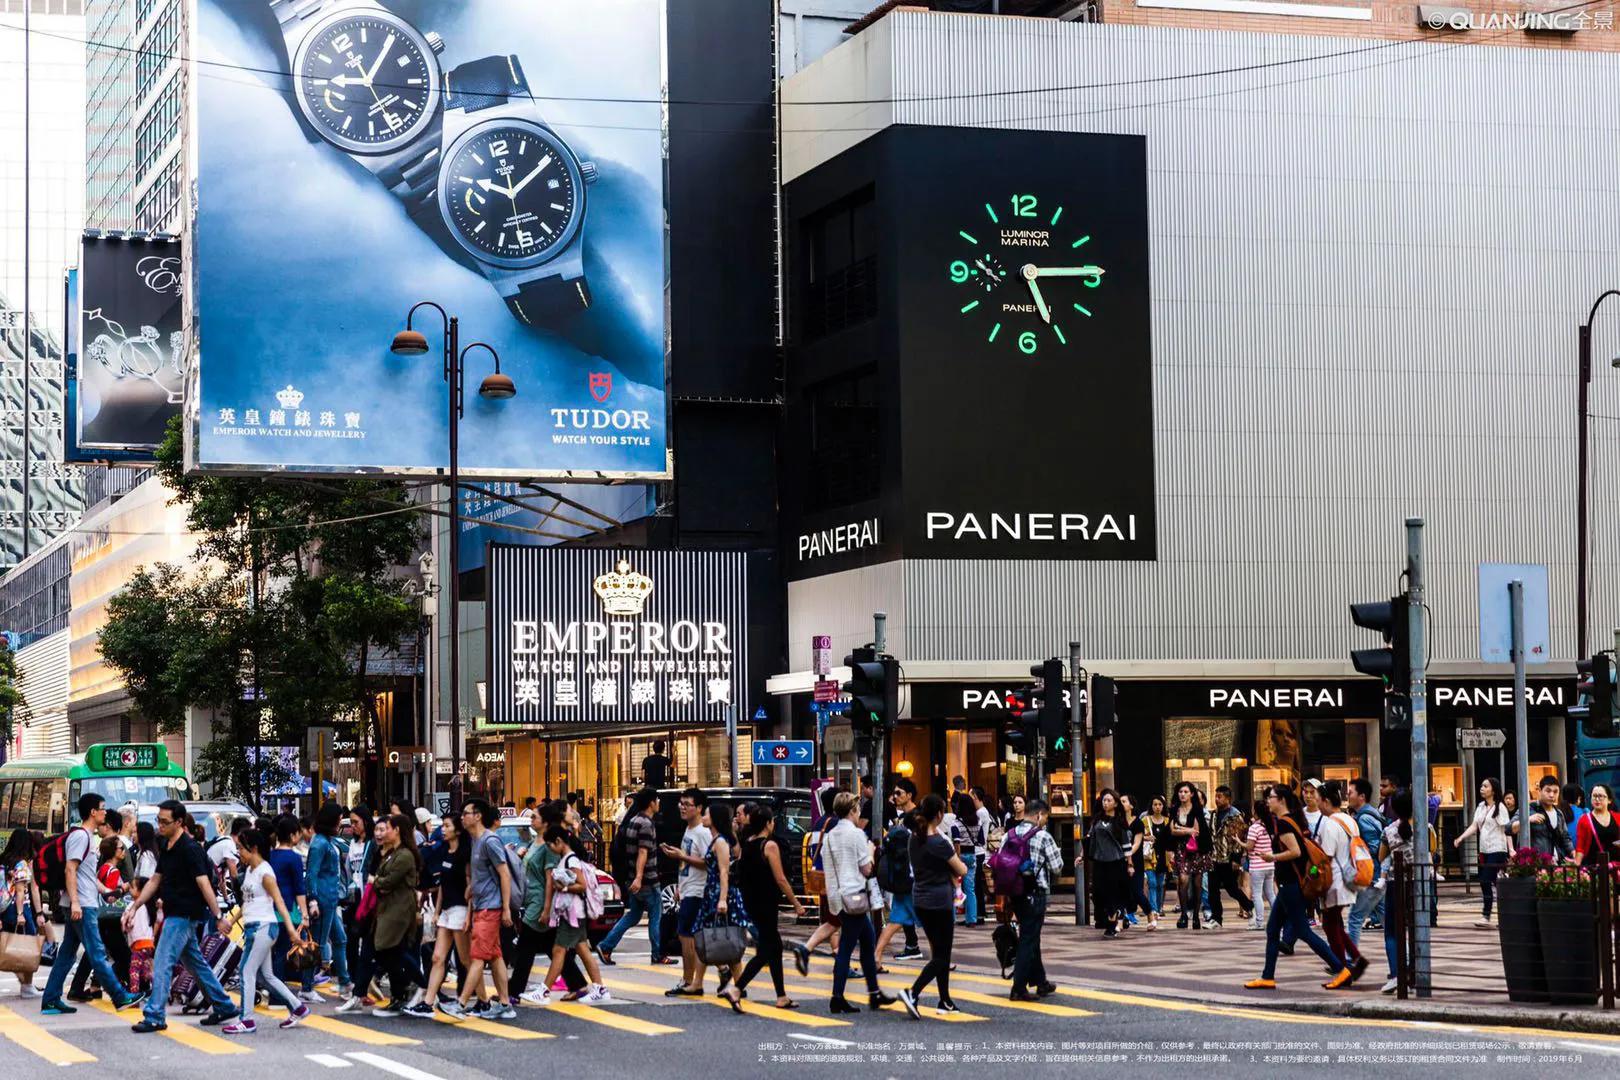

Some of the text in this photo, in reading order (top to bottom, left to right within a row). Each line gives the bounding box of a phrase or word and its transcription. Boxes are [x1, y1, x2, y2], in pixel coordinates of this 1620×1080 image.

[489, 139, 509, 157] 12
[1011, 194, 1038, 217] 12
[516, 230, 534, 248] 6
[1001, 230, 1049, 239] LUMINOR
[1001, 238, 1050, 247] MARINA
[950, 260, 968, 283] 9
[1002, 304, 1052, 313] PANEI
[1018, 331, 1037, 354] 6
[551, 409, 651, 430] TUDOR
[213, 427, 367, 439] EMPEROR WATCH AND JEWELLERY
[552, 435, 651, 446] WATCH YOUR STYLE
[927, 512, 1136, 541] PANERAI
[799, 517, 879, 562] PANERAI
[513, 621, 732, 654] EMPEROR
[513, 660, 732, 673] WATCH AND JEWELLERY
[1210, 688, 1343, 708] PANERAI
[1435, 687, 1563, 707] PANERAI
